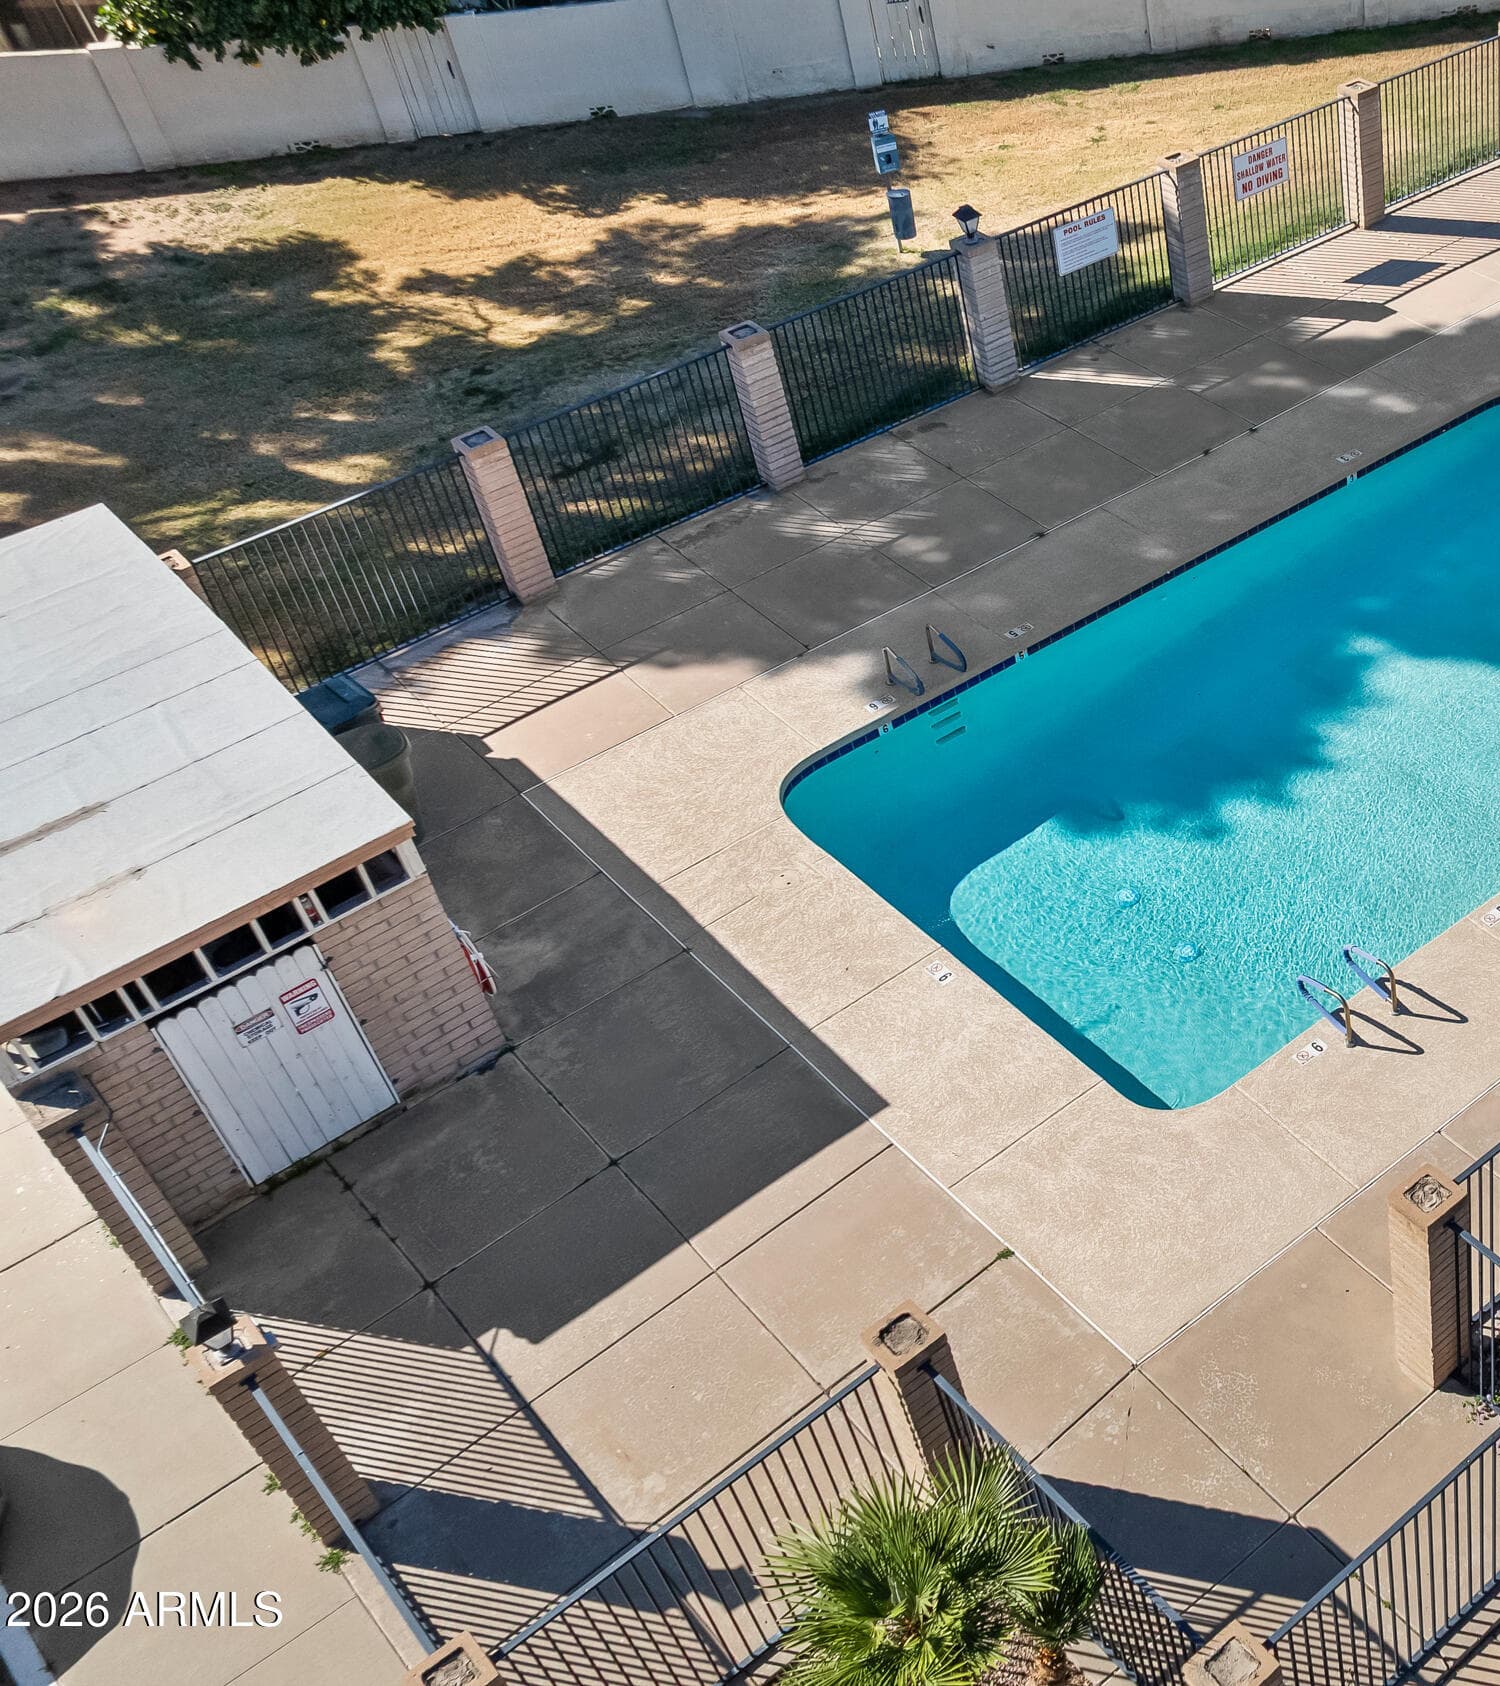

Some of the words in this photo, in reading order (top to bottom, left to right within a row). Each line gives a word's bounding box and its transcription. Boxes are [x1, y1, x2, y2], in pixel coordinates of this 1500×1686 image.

[1248, 147, 1273, 164] DANGER
[1236, 162, 1264, 181] SHALLOW
[1266, 153, 1286, 168] WATER
[1242, 180, 1253, 194] NO
[1256, 167, 1283, 188] DIVING
[1063, 224, 1082, 236] POOL
[1084, 214, 1106, 228] RULES
[882, 724, 889, 734] 6
[1311, 1042, 1324, 1052] 6
